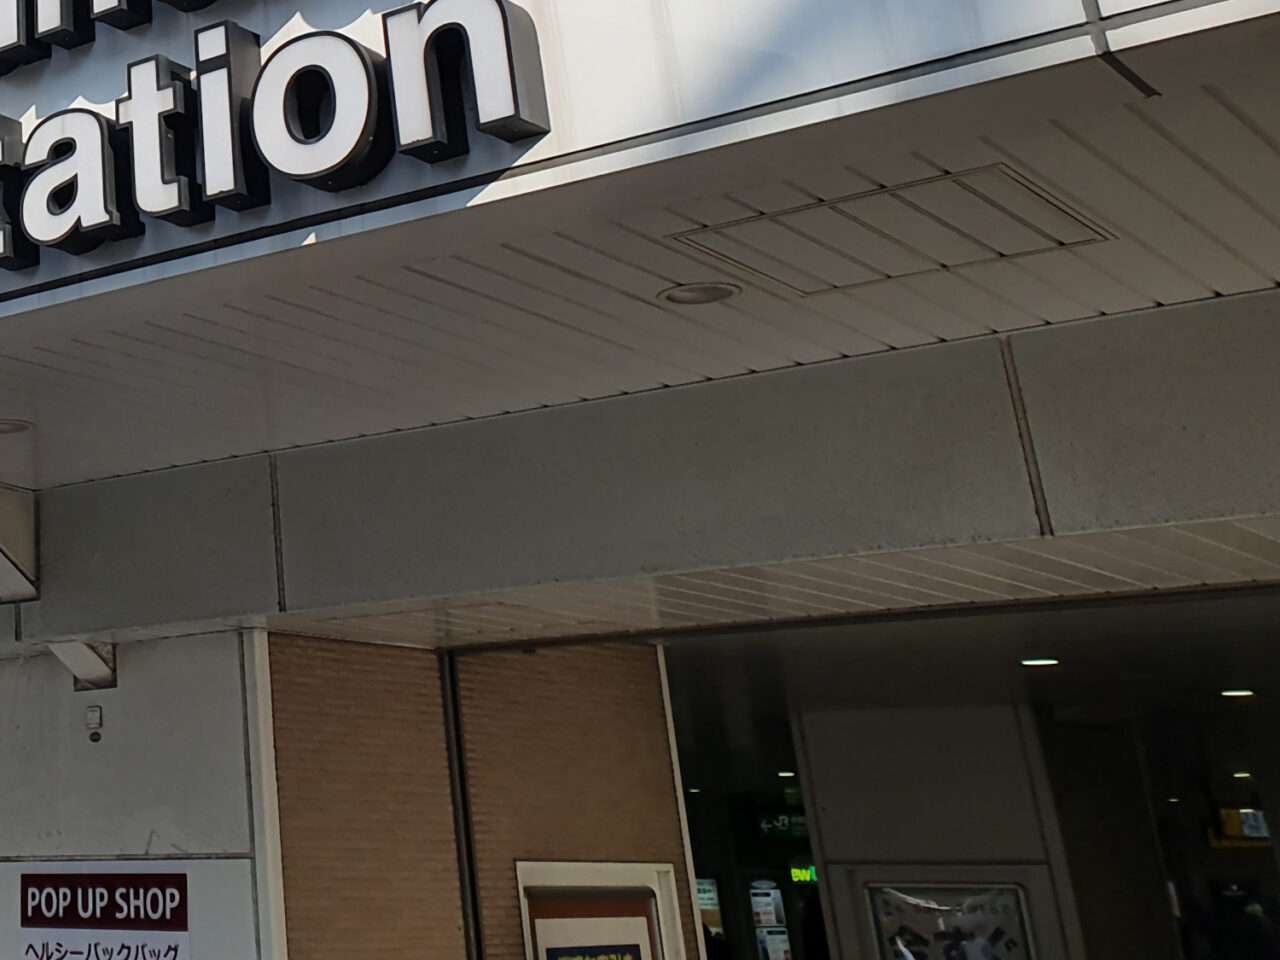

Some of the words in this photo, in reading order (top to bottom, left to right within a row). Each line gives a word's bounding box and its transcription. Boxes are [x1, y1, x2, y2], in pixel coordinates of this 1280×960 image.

[26, 887, 72, 918] POP
[76, 887, 109, 919] UP
[114, 887, 181, 920] SHOP
